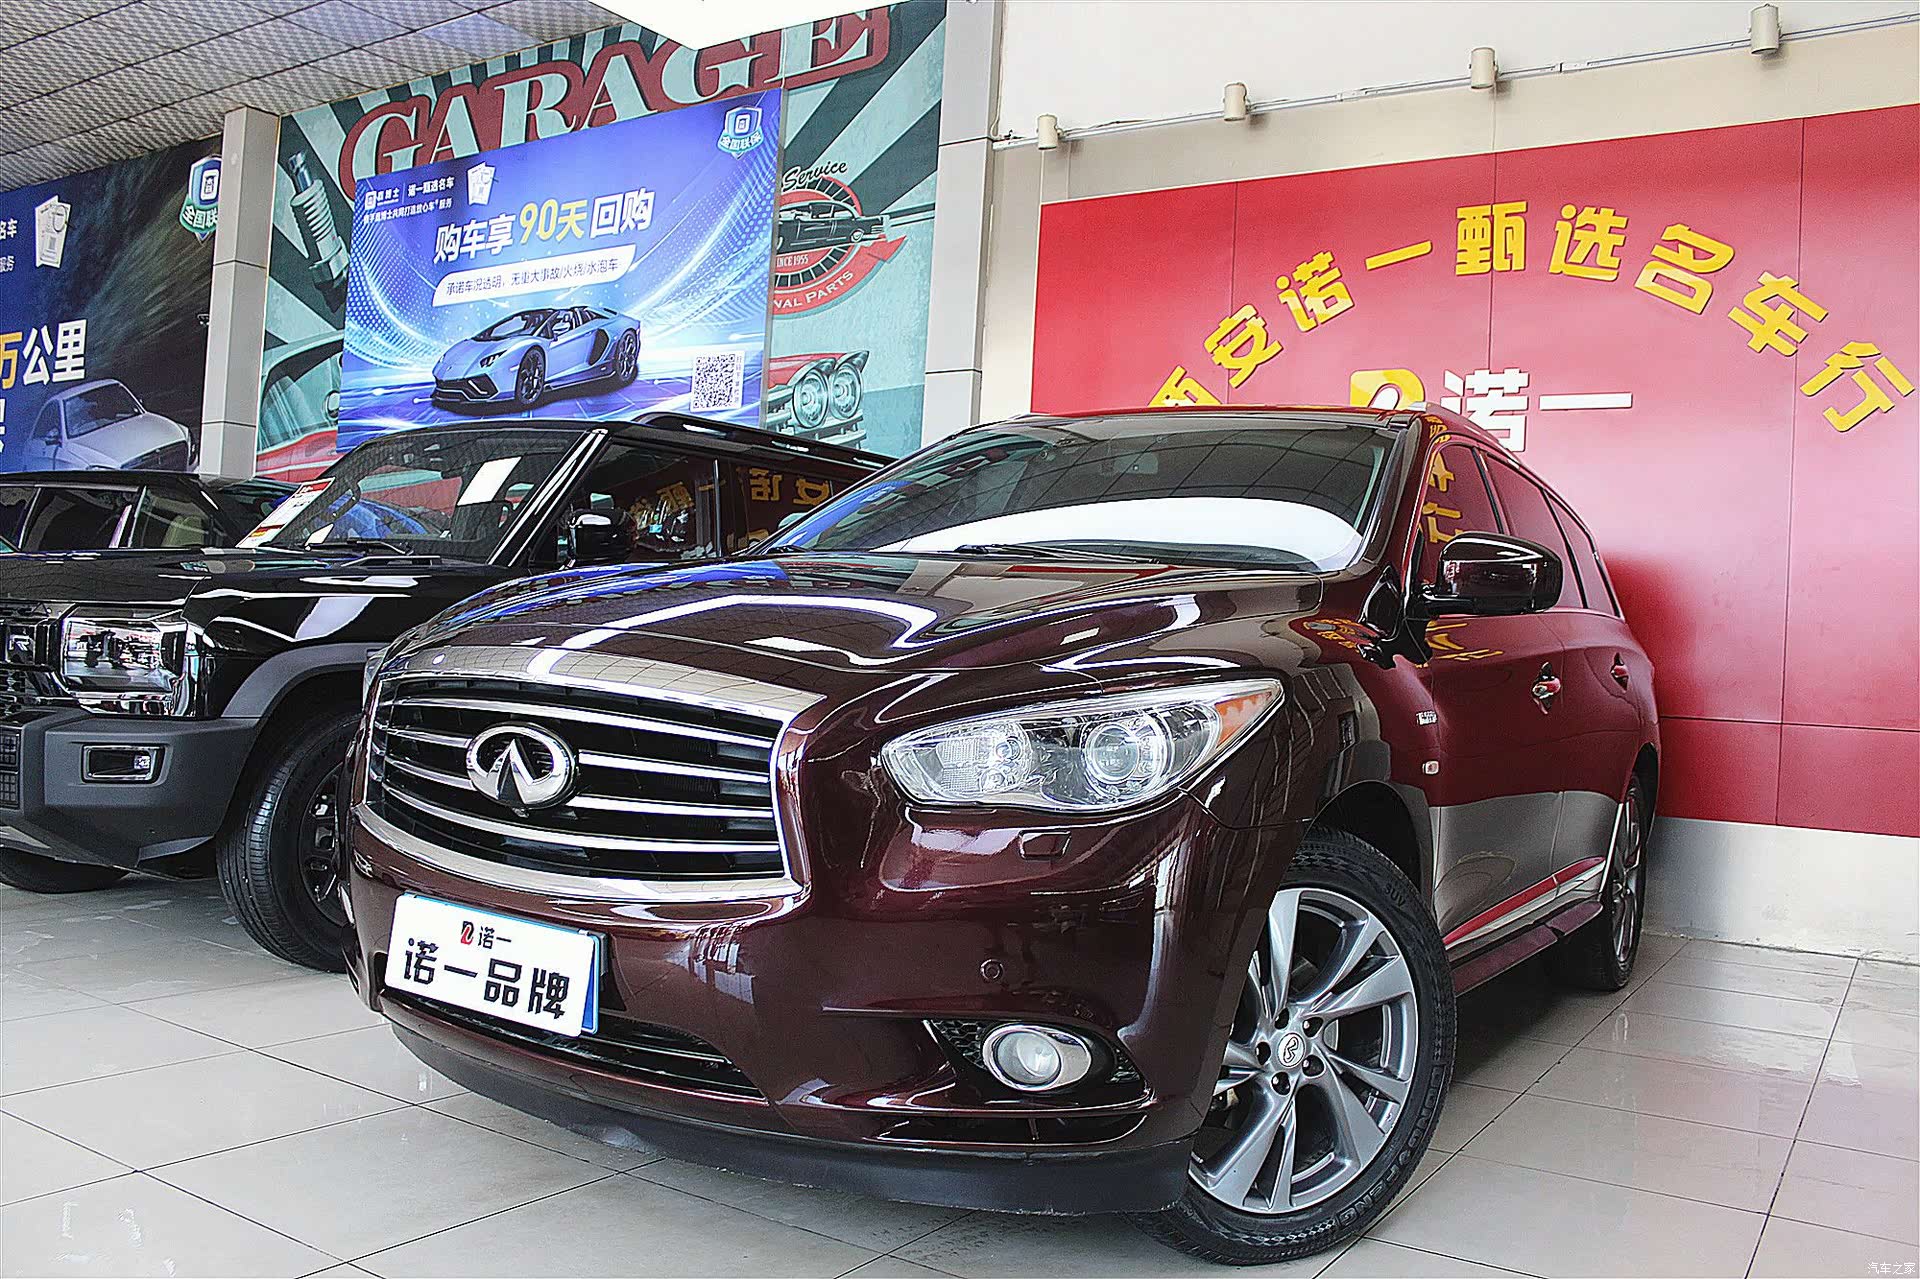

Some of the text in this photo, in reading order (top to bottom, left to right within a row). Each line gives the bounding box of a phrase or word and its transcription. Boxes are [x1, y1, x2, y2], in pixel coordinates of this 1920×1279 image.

[351, 14, 870, 180] GARAGE
[783, 161, 848, 191] Service
[805, 270, 854, 304] PARTS
[1440, 367, 1633, 452] 诺一
[478, 925, 512, 949] 诺一
[403, 937, 570, 1020] 诺一品牌
